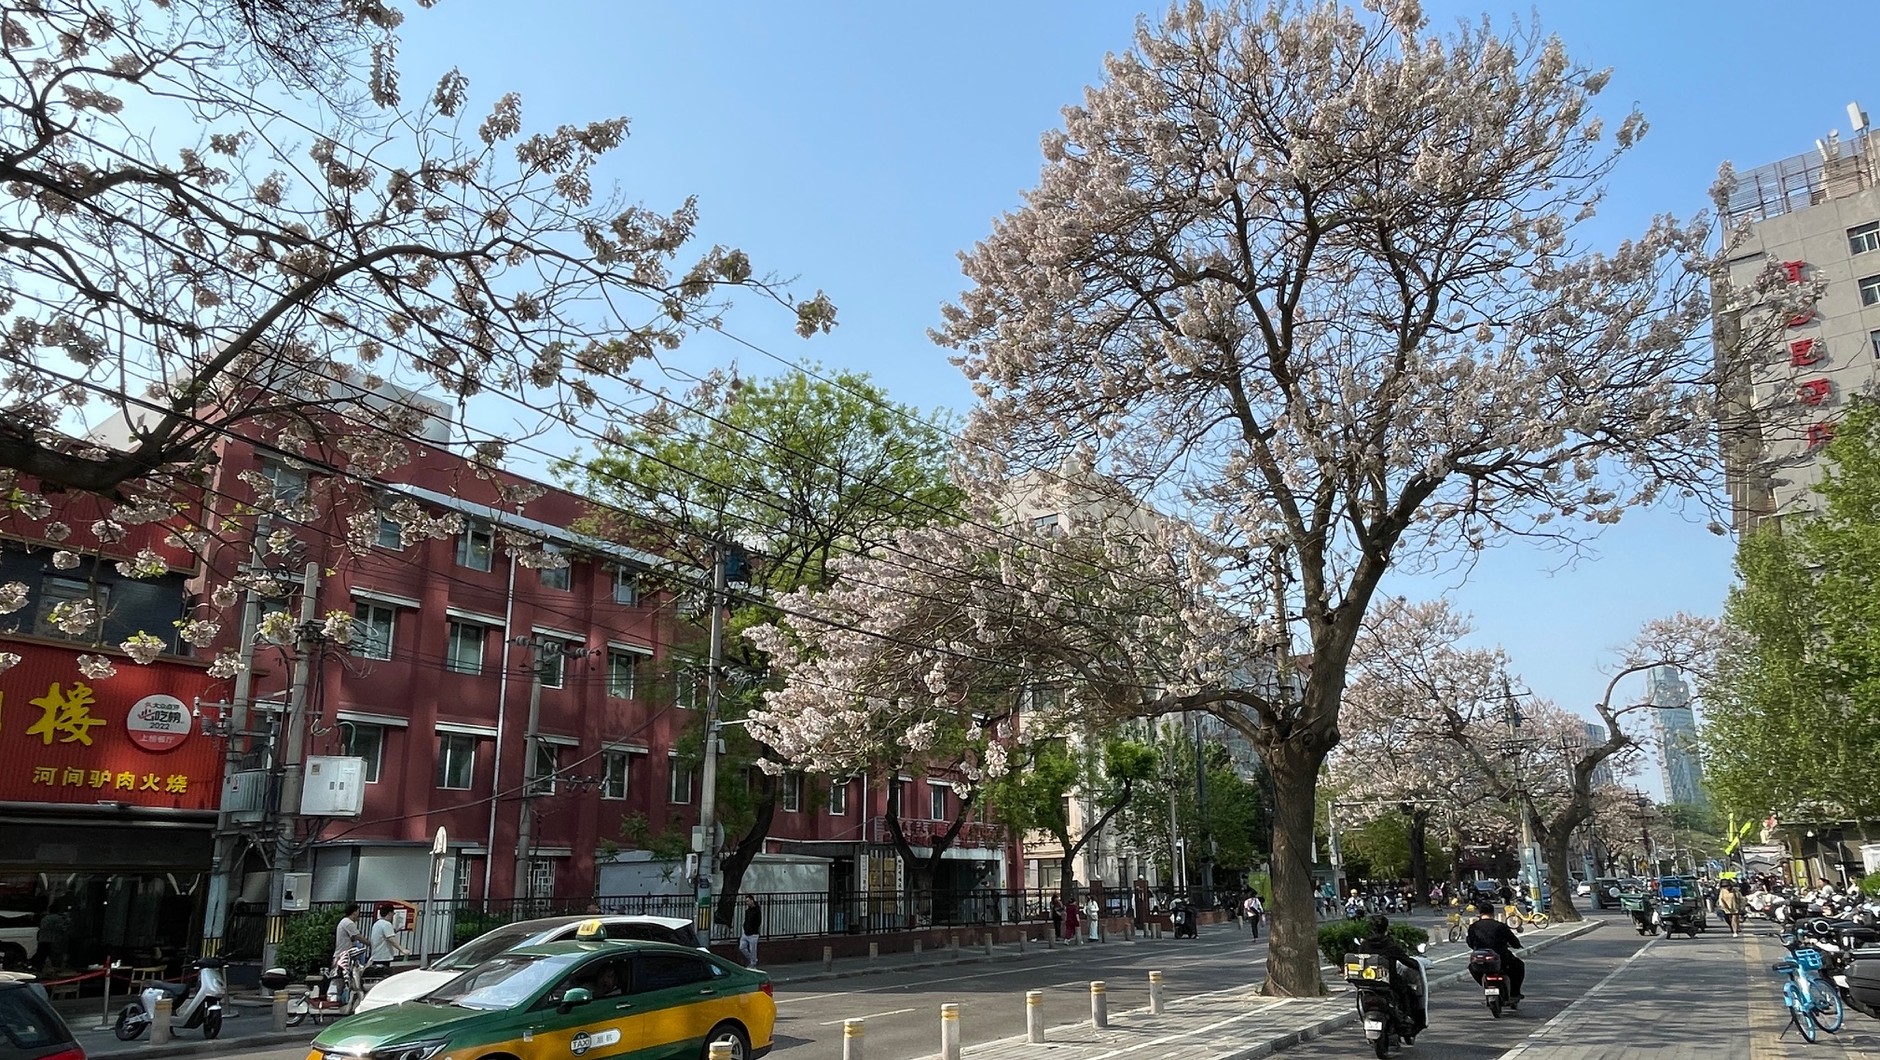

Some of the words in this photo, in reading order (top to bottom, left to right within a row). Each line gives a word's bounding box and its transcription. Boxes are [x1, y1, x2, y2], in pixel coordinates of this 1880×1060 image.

[0, 681, 107, 746] 楼
[137, 709, 182, 724] 必吃榜
[149, 722, 171, 730] 2022
[32, 766, 188, 794] 河间驴肉火烧
[573, 1039, 590, 1047] TAXI
